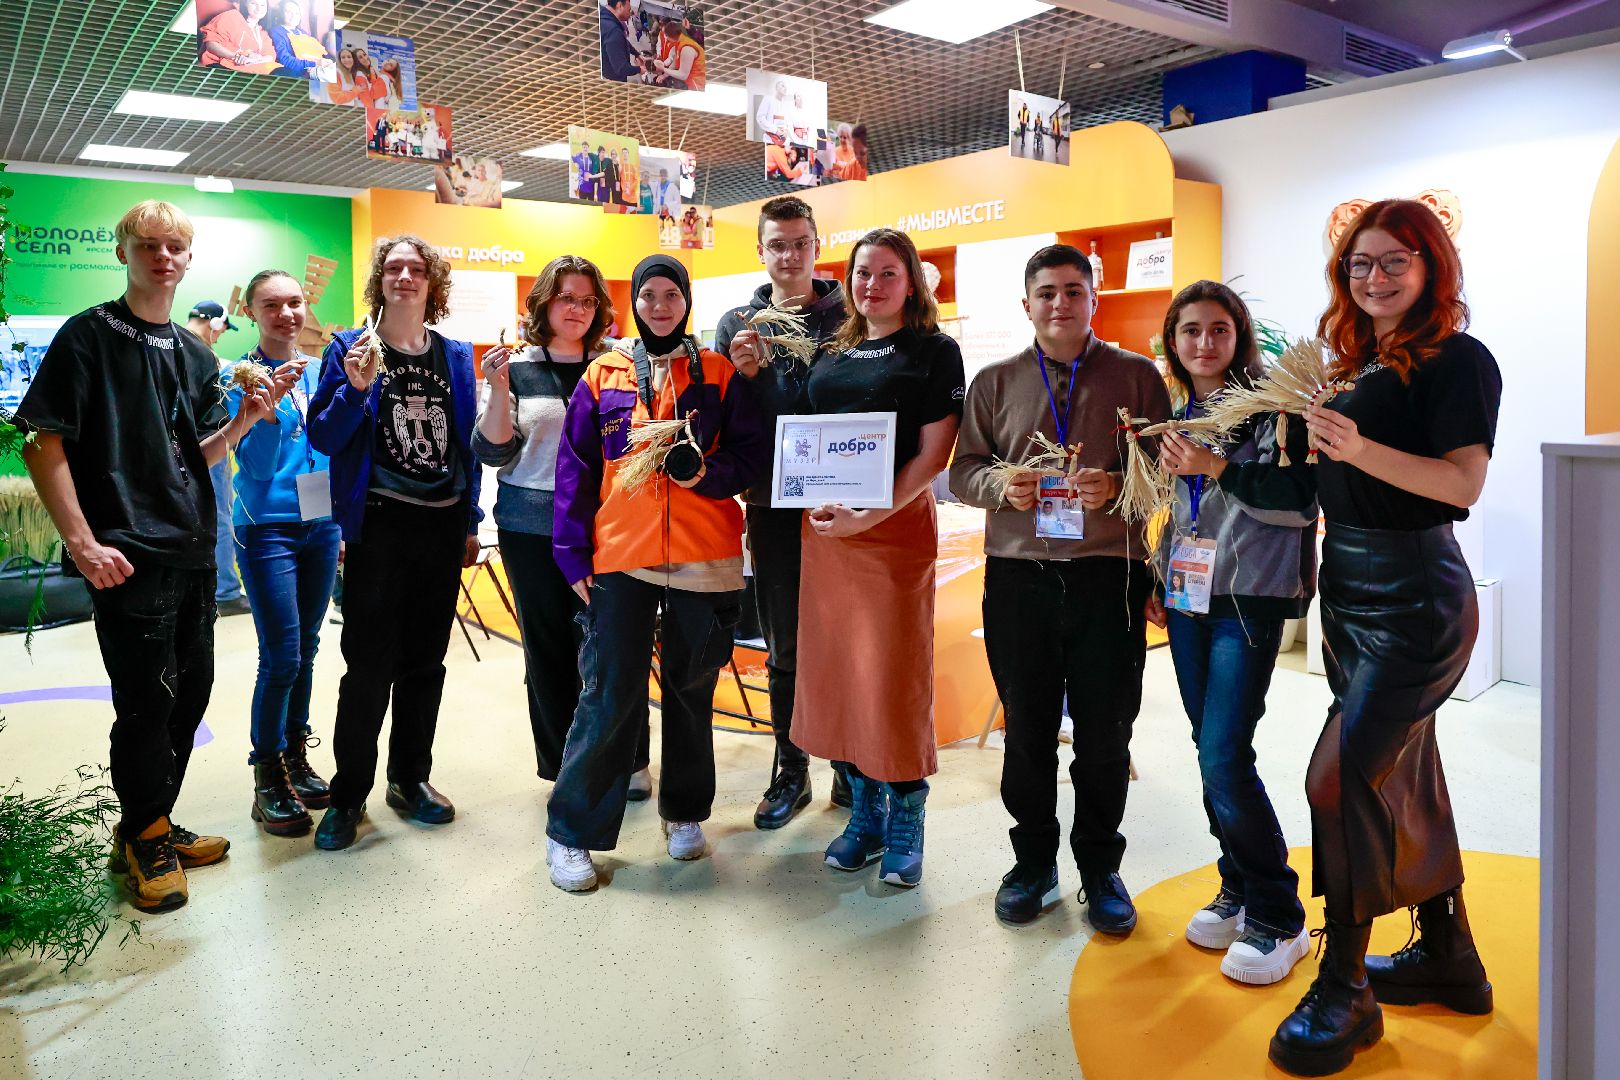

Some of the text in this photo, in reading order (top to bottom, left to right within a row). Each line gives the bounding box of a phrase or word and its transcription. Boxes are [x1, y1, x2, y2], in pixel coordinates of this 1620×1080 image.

[897, 200, 1005, 233] #МЫВМЕСТЕ
[15, 241, 71, 255] СЕЛА
[467, 244, 525, 266] добра
[407, 382, 425, 391] INC.
[827, 438, 877, 455] добро
